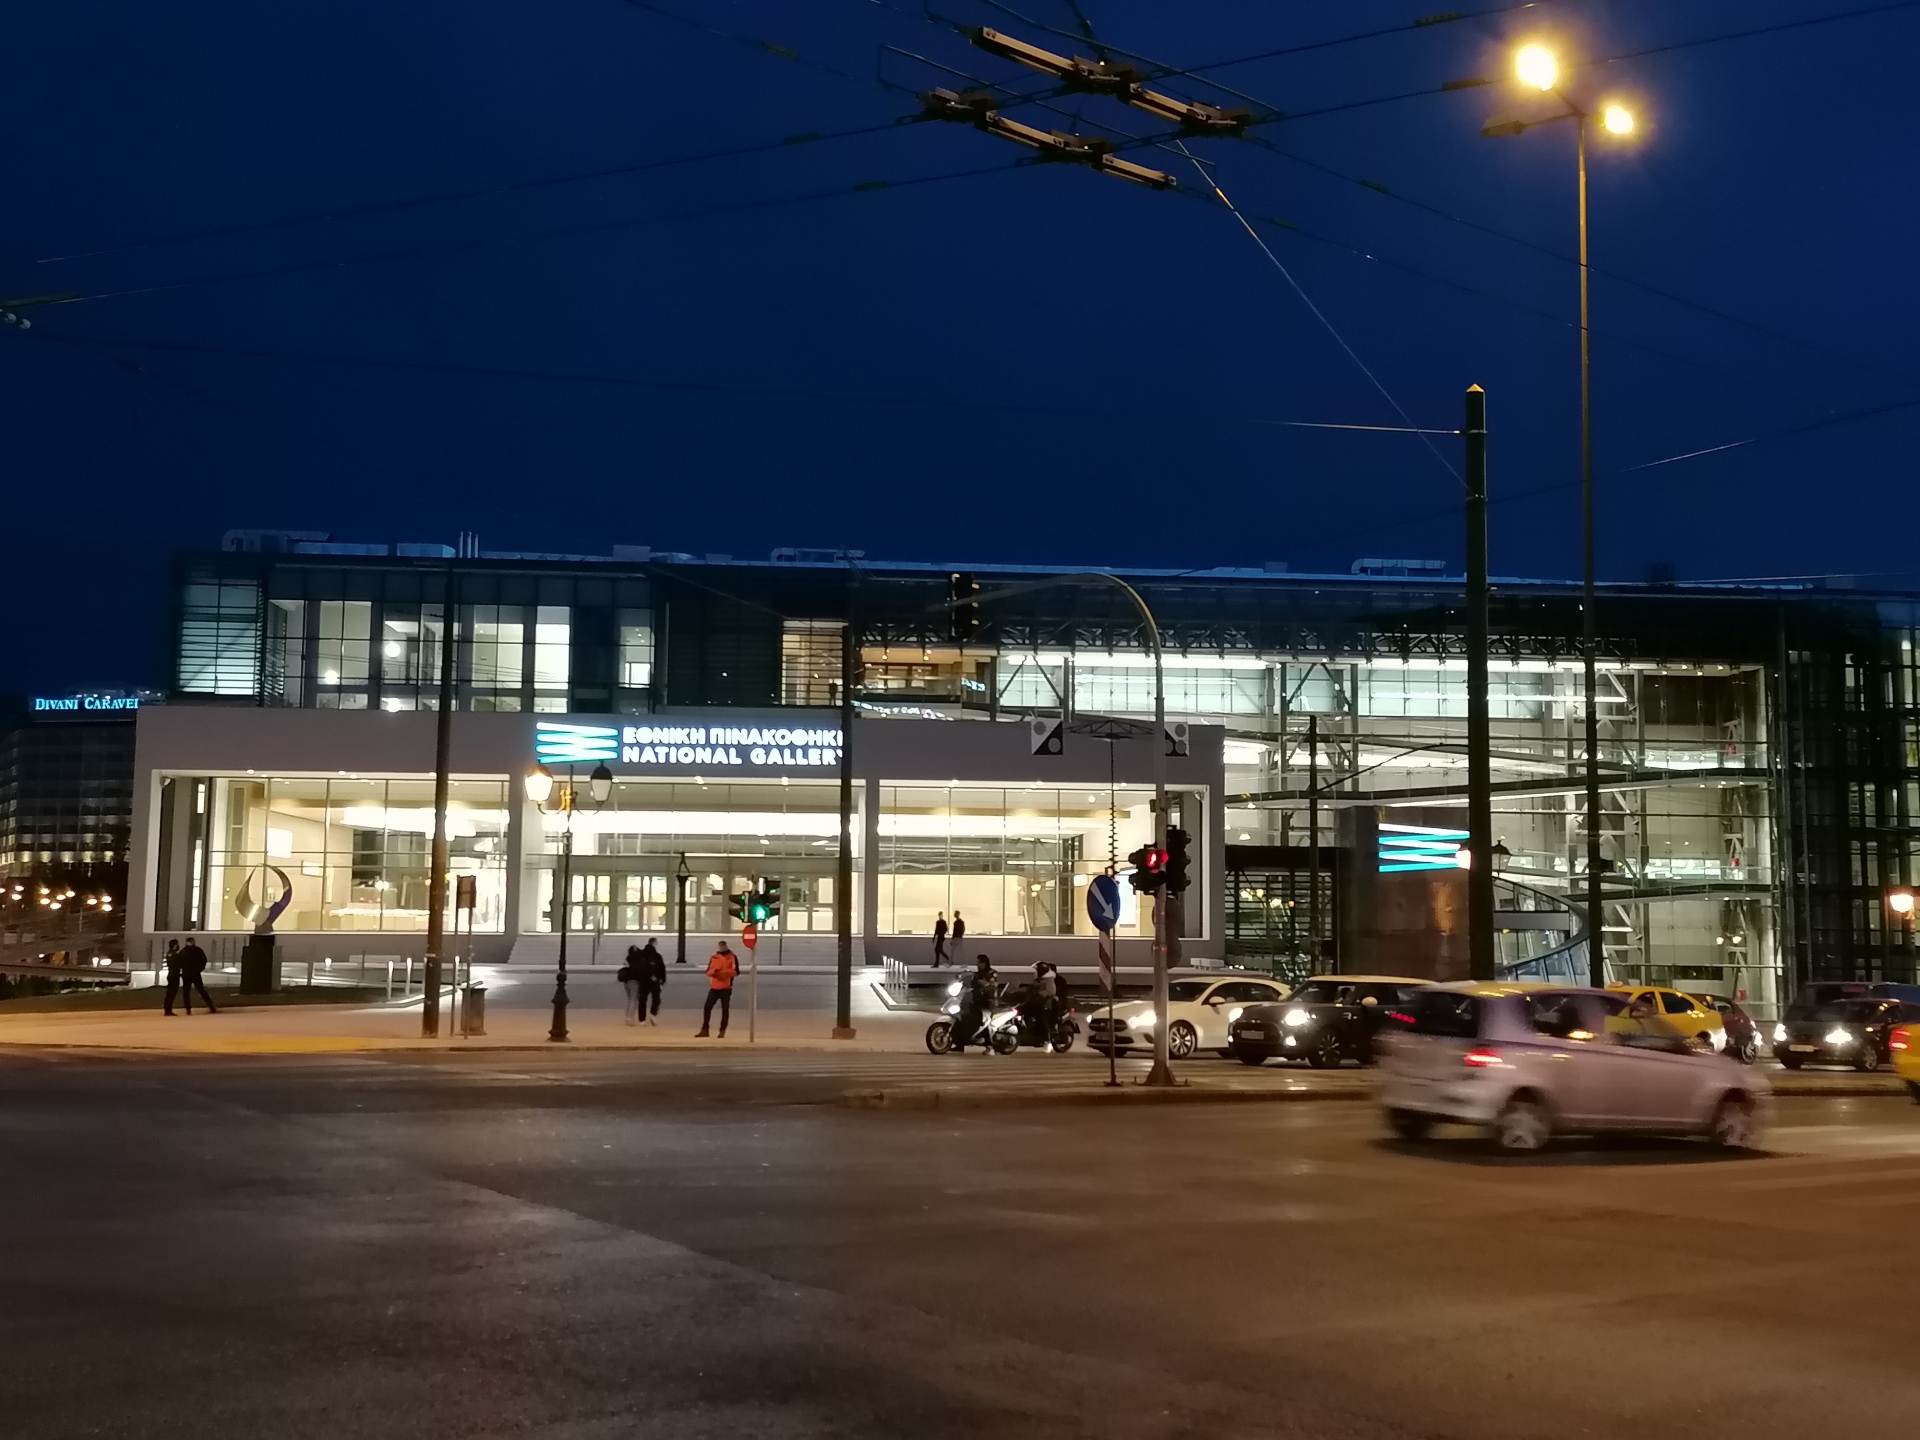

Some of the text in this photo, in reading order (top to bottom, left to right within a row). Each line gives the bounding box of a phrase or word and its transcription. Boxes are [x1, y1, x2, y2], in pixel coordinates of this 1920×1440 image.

[35, 698, 79, 710] DIVANI
[622, 726, 706, 745] ΕΘΝΙΚΗ
[622, 745, 844, 766] NATIONAL GALLER
